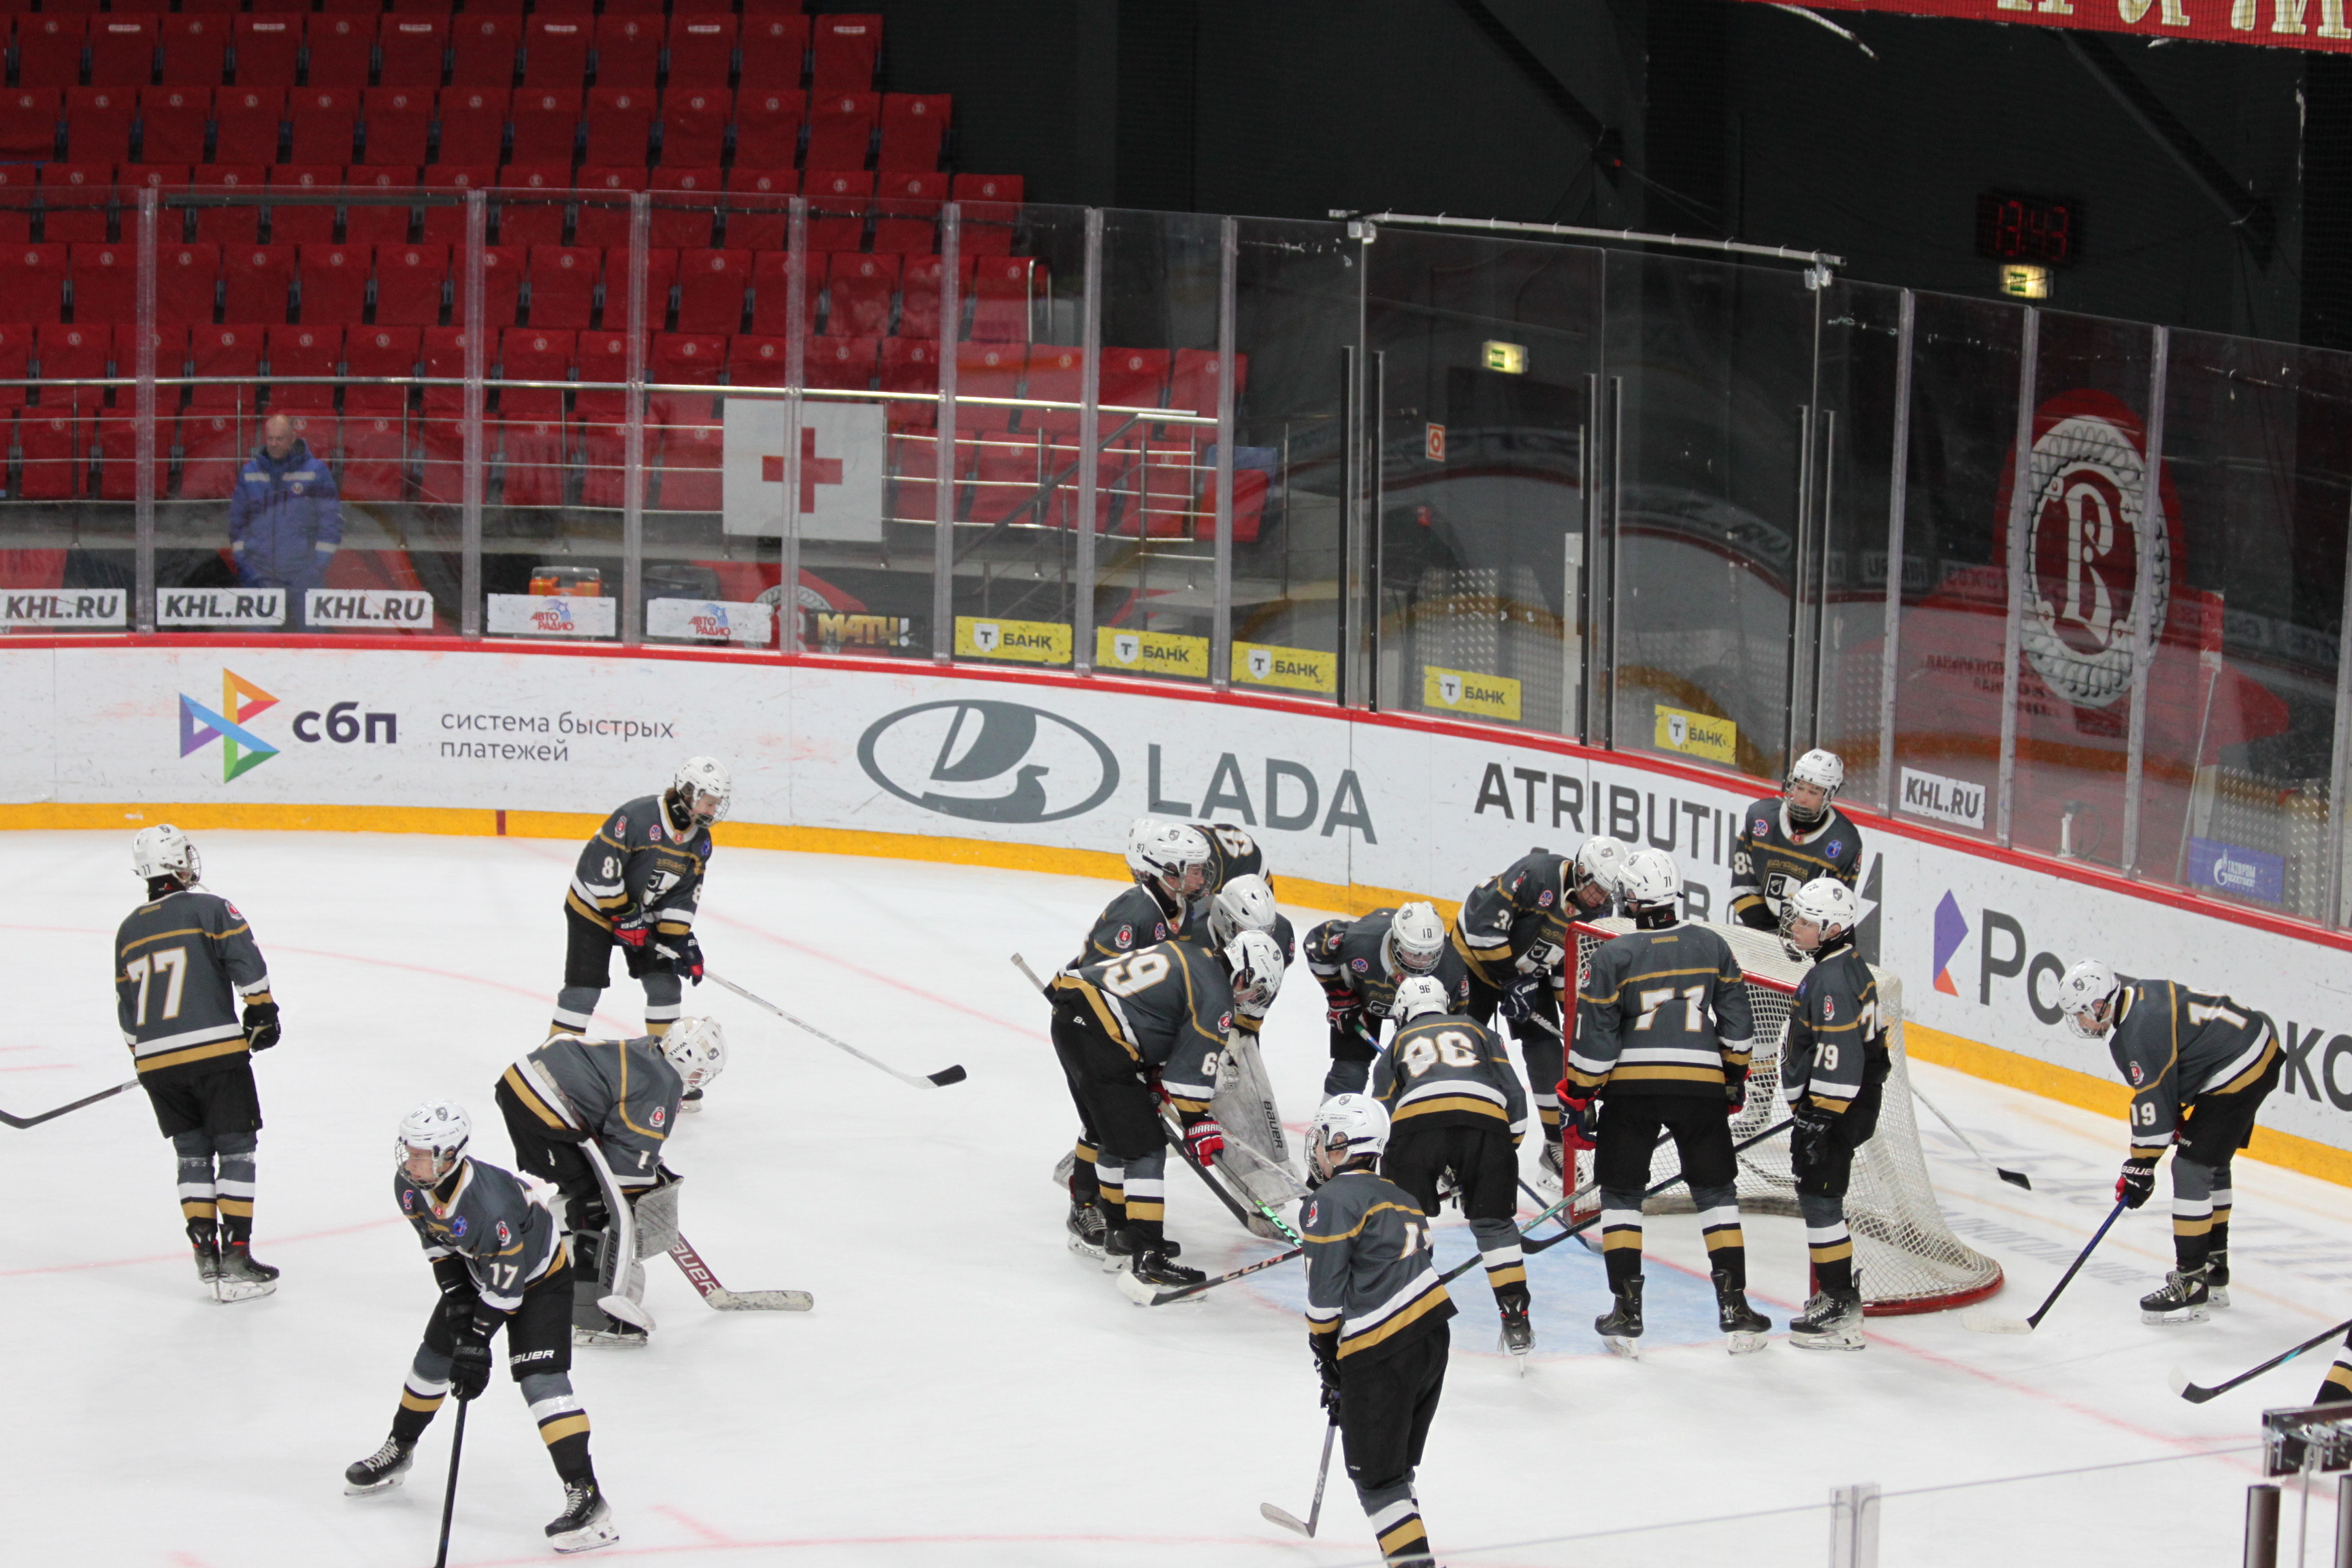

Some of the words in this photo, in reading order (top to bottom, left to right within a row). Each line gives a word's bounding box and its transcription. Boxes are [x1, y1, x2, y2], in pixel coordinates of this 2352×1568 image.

[6, 595, 117, 619] KHL.RU
[165, 595, 278, 619] KHL.RU
[313, 596, 425, 621] KHL.RU
[538, 621, 574, 631] РАДИО
[696, 625, 731, 636] РАДИО
[1003, 632, 1053, 650] БАНК
[1143, 644, 1190, 663] БАНК
[1275, 659, 1320, 679] БАНК
[1465, 685, 1505, 705] БАНК
[293, 702, 397, 744] сбп
[441, 713, 549, 734] система
[559, 711, 674, 742] быстрых
[1688, 725, 1723, 745] БАНК
[440, 738, 568, 762] платежей
[1147, 743, 1378, 845] LADA
[1905, 776, 1980, 819] KHL.RU
[1136, 843, 1145, 853] 97
[602, 856, 622, 879] 81
[1422, 928, 1433, 938] 10
[125, 947, 187, 1026] 77
[1419, 984, 1431, 994] 96
[1634, 985, 1705, 1032] 71
[1401, 1030, 1481, 1078] 96
[1263, 1100, 1284, 1149] BAUER
[489, 1263, 519, 1290] 17
